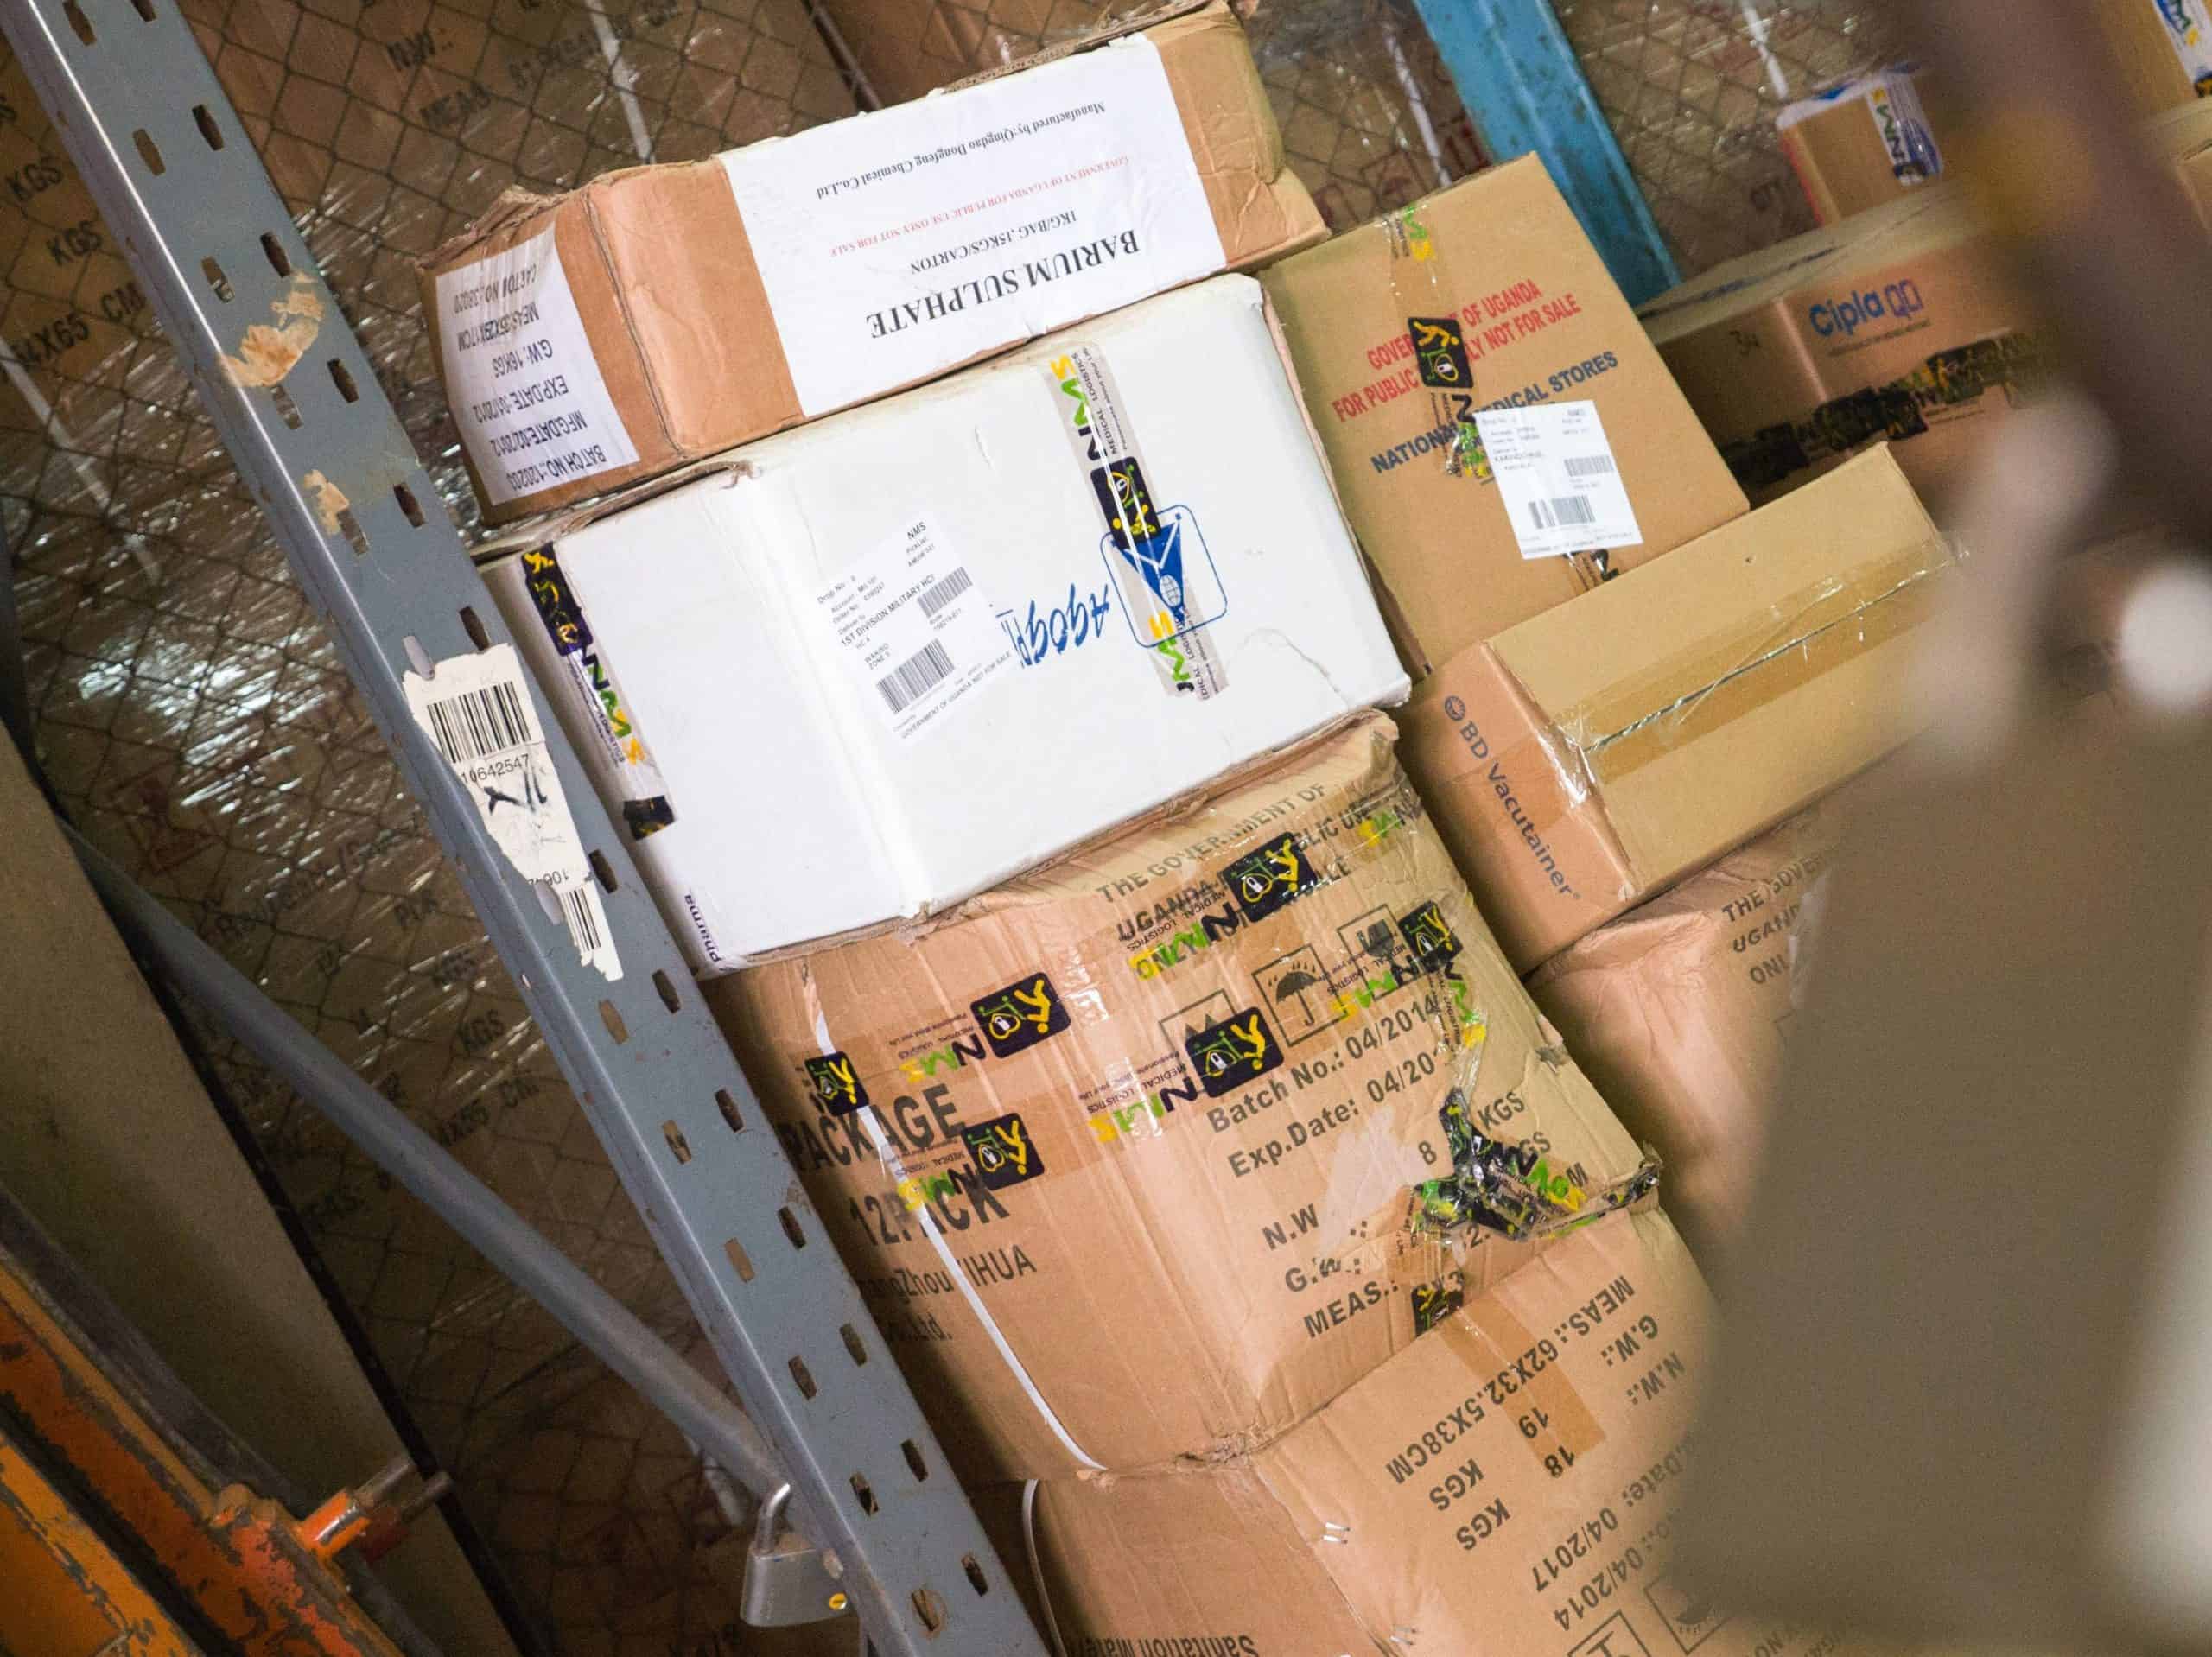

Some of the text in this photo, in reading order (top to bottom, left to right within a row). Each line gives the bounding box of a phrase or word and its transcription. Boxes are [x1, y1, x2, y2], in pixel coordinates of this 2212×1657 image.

[1033, 101, 1105, 132] Manufactured
[862, 160, 914, 185] Chemical
[914, 143, 967, 168] Dongfeng
[1063, 155, 1129, 186] GOVERNMENT
[950, 200, 985, 219] PUBLIC
[987, 194, 1008, 208] FOR
[1007, 181, 1048, 203] UGANDA
[830, 242, 855, 258] SALE
[857, 236, 879, 251] FOR
[880, 227, 902, 243] NOT
[866, 228, 1141, 339] BARIUM SULPHATE
[1461, 303, 1483, 328] OF
[1481, 278, 1542, 321] UGANDA
[1809, 289, 1885, 337] Cipla
[1332, 391, 1370, 422] FOR
[1369, 367, 1420, 410] PUBLIC
[1484, 322, 1517, 351] NOT
[1515, 308, 1547, 338] FOR
[1541, 292, 1582, 326] SALE
[1547, 350, 1619, 394] STORES
[1094, 407, 1119, 454] MEDICAL
[568, 444, 607, 473] BATCH
[905, 520, 927, 540] NMS
[839, 632, 857, 647] 1ST
[854, 607, 889, 636] DIVISION
[887, 583, 922, 613] MILITARY
[1460, 721, 1489, 759] BD
[460, 754, 531, 784] 10642547
[1097, 871, 1154, 903] THE
[1299, 783, 1326, 804] OF
[1722, 889, 1764, 923] THE
[1124, 918, 1179, 953] LOGISTICS
[898, 1032, 986, 1082] NMS
[1140, 1063, 1187, 1090] MEDICAL
[1206, 1080, 1289, 1133] Batch
[1290, 1050, 1344, 1089] No.:
[1345, 994, 1442, 1059] 04/2014
[1477, 1091, 1526, 1131] KGS
[1227, 1098, 1360, 1178] Exp.Date:
[957, 1244, 1037, 1287] IHUA
[1303, 1279, 1400, 1340] MEAS.:
[1385, 1274, 1636, 1484] MEAS.: 62X32.5X38CM
[1429, 1314, 1659, 1511] G.W.: 19 KGS
[1543, 1445, 1575, 1478] 18
[1455, 1498, 1510, 1550] KGS
[1532, 1507, 1618, 1592] 04/2017
[1554, 1546, 1643, 1632] 04/2014
